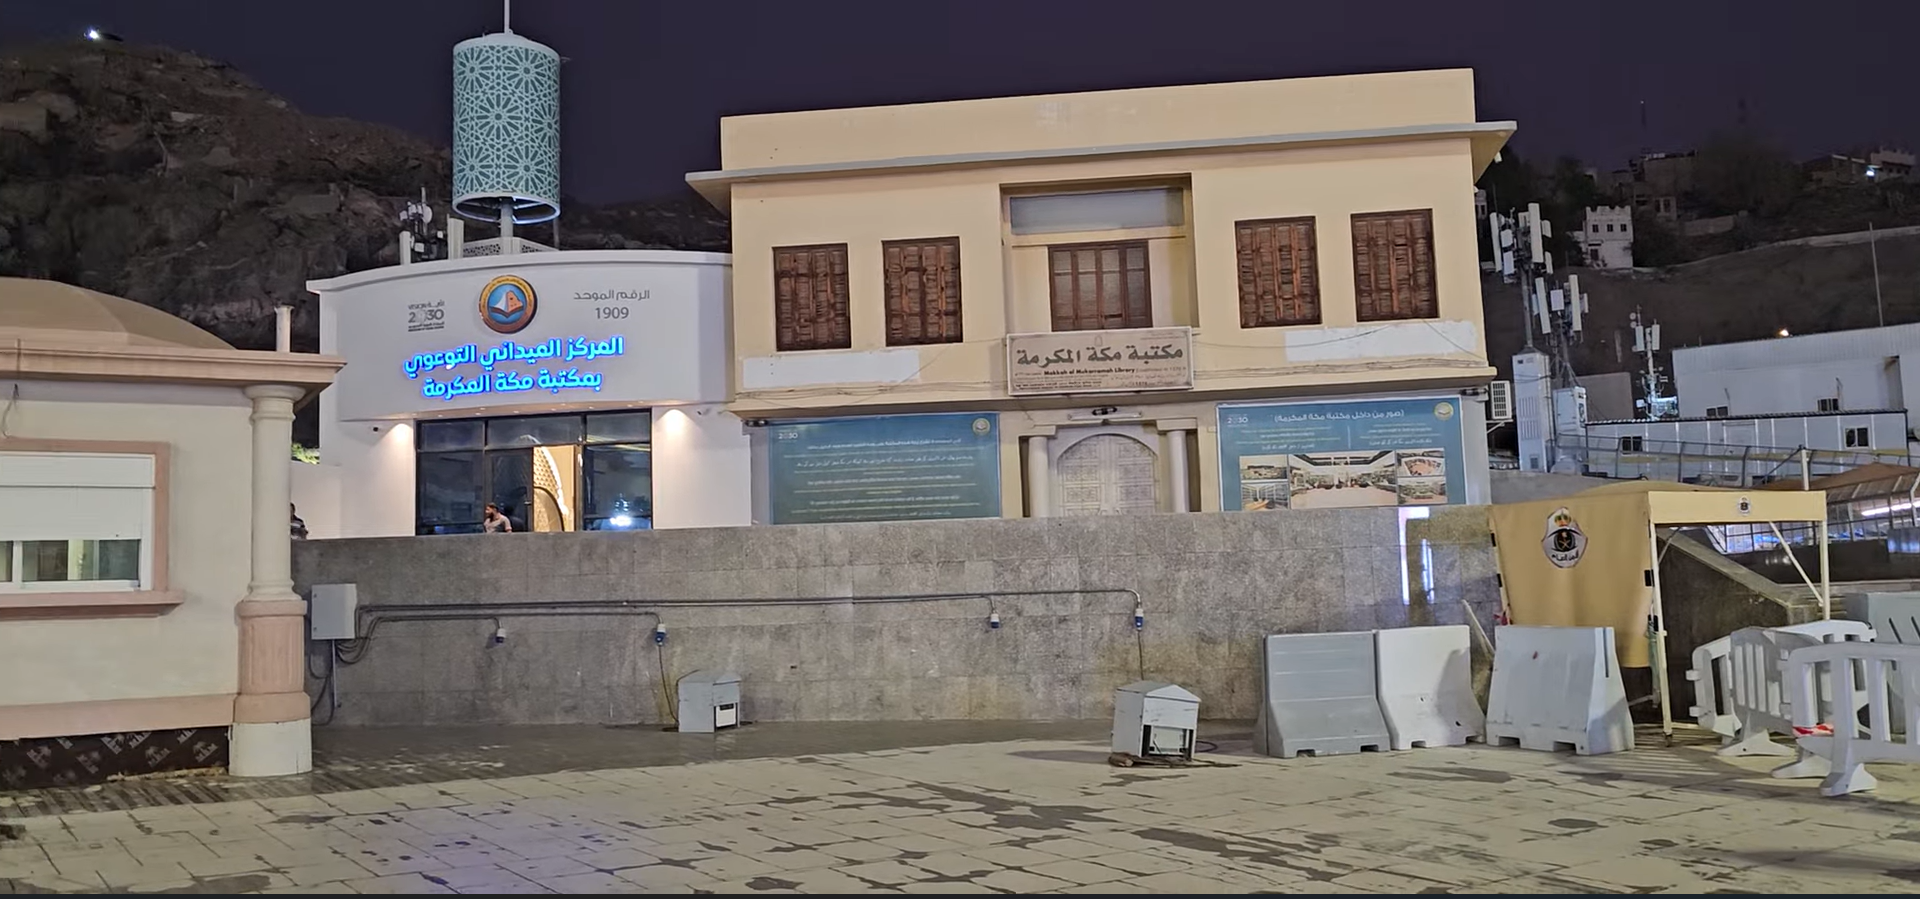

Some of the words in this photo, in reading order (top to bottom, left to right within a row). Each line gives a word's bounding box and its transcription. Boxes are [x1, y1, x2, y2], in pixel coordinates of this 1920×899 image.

[573, 290, 614, 301] الموحد
[615, 290, 650, 301] الرقم
[408, 308, 445, 323] 2030
[595, 307, 629, 320] 1909
[480, 338, 562, 370] الميداني
[565, 336, 625, 362] المركز
[1016, 348, 1081, 368] المكرمة
[1086, 346, 1122, 362] مكة
[1126, 344, 1183, 365] مكتبة
[404, 344, 477, 380] التوعوي
[1115, 366, 1136, 375] Library
[423, 374, 491, 400] المكرمة
[495, 371, 533, 392] مكة
[538, 368, 602, 393] بمكتبة
[1352, 411, 1372, 420] داخل
